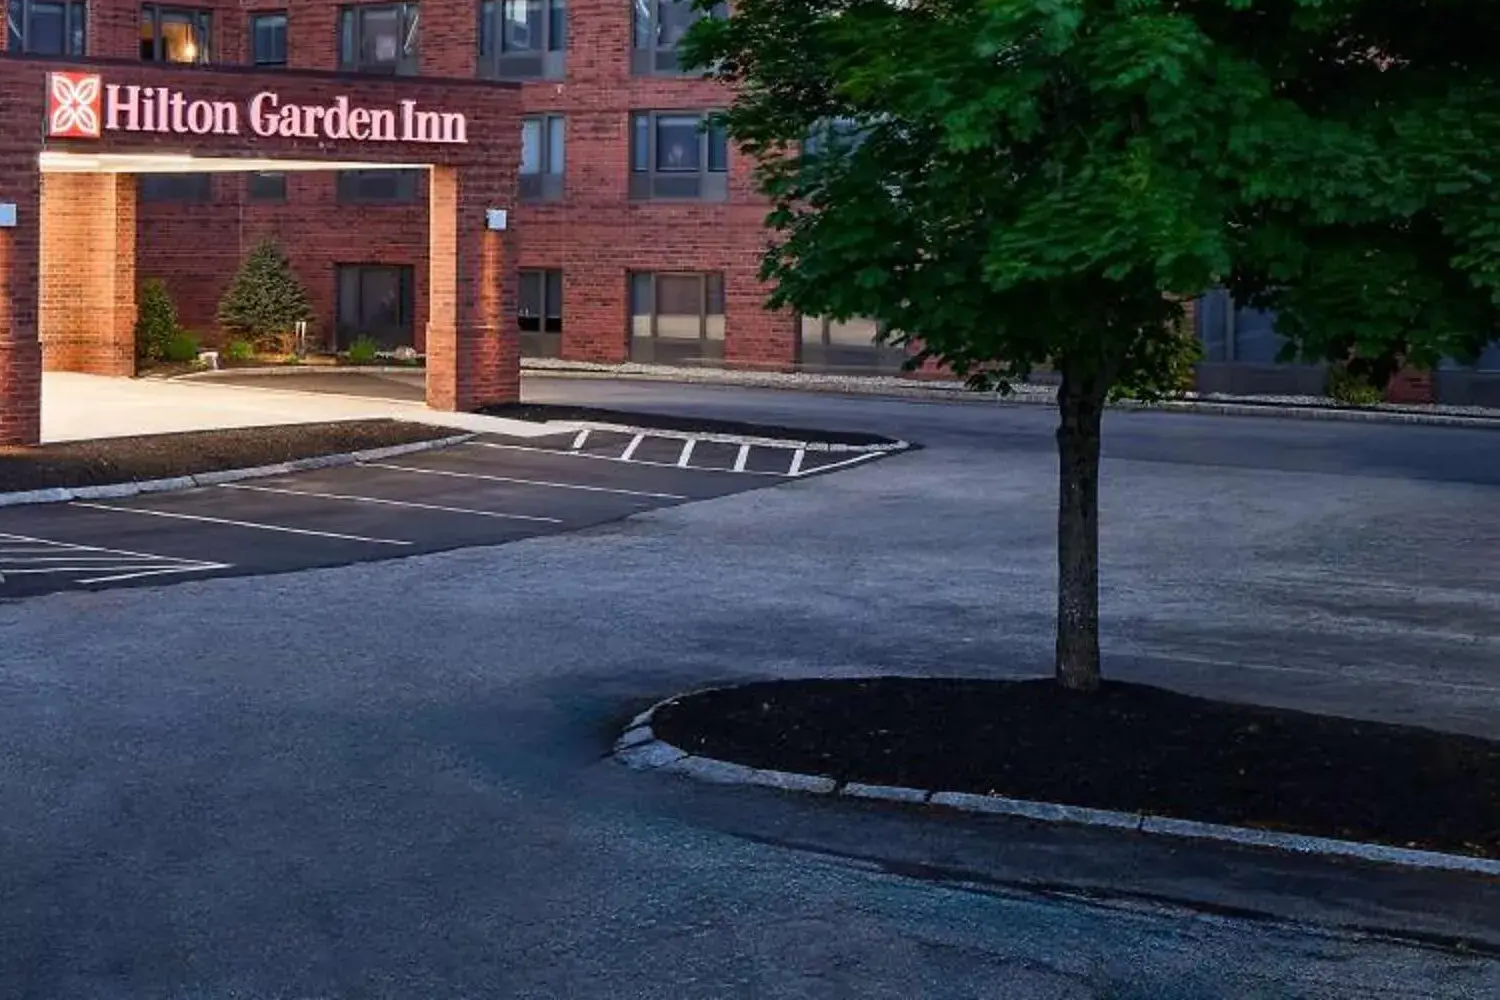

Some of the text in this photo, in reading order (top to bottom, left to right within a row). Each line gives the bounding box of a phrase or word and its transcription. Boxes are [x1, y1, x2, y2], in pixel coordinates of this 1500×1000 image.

[106, 83, 468, 143] Hilton Garden Inn
